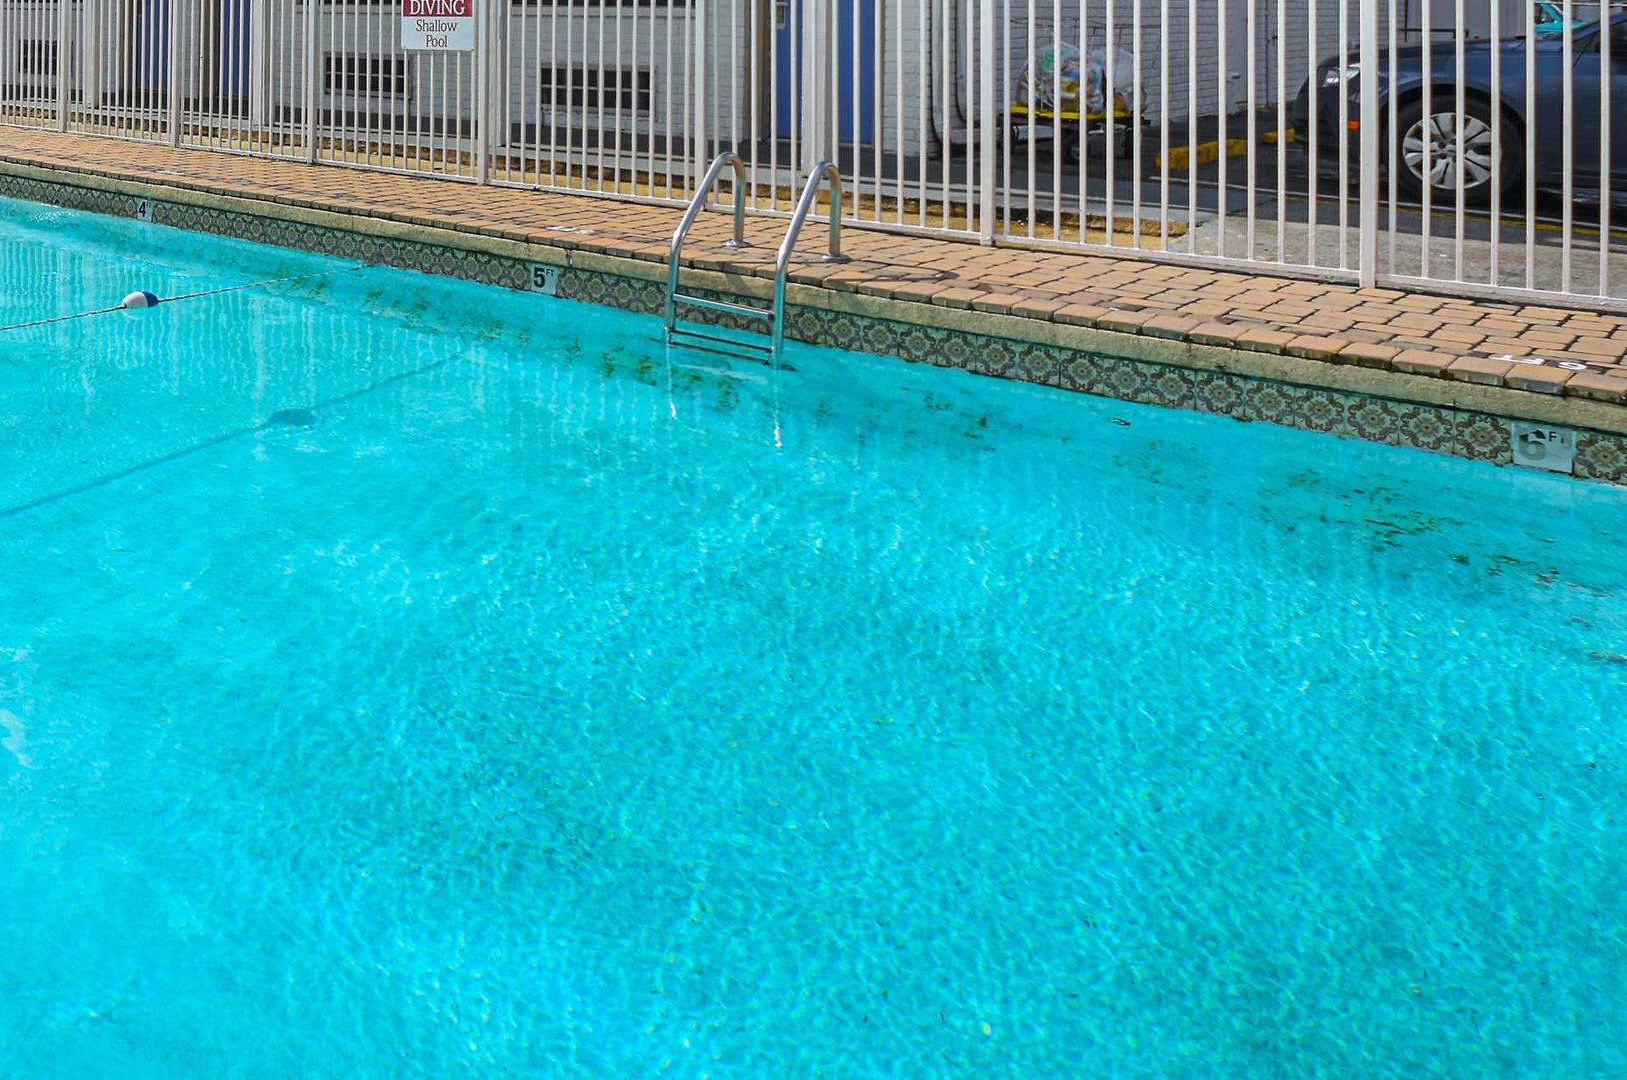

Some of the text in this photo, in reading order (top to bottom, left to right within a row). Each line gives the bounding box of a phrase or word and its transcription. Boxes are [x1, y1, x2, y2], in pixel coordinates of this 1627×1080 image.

[410, 0, 465, 15] DIVING
[416, 19, 457, 32] Shallow
[426, 35, 448, 48] Pool
